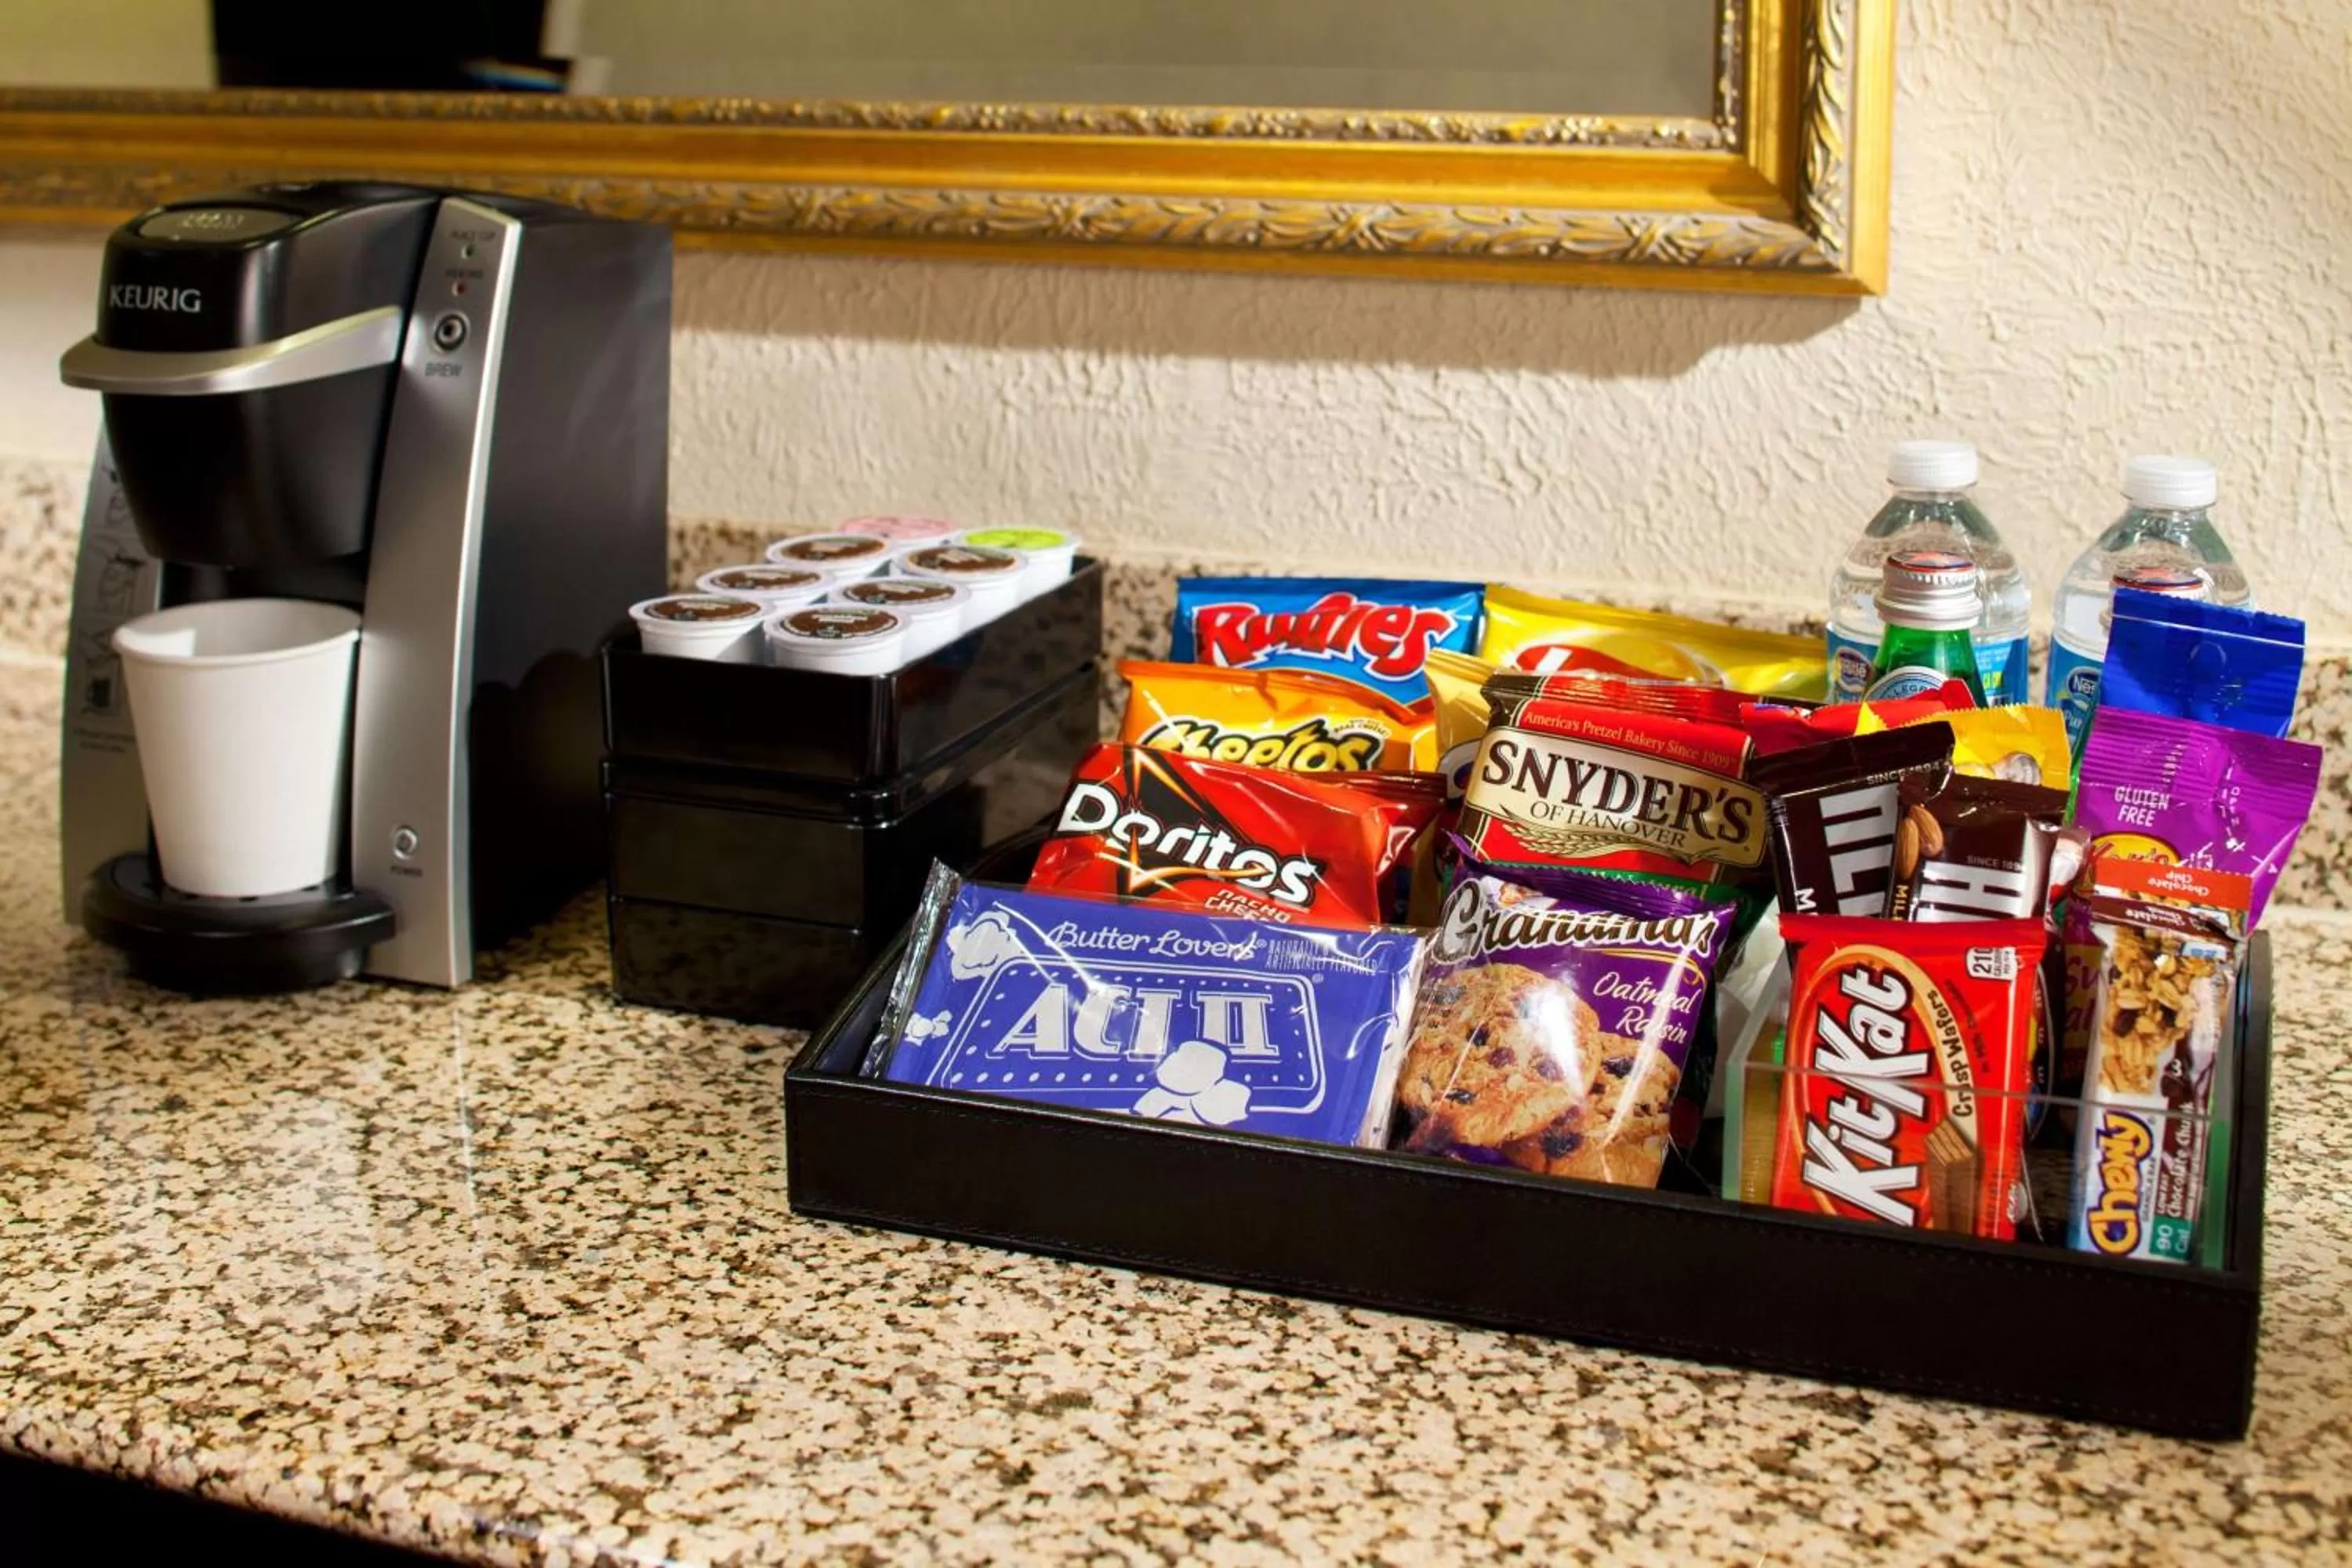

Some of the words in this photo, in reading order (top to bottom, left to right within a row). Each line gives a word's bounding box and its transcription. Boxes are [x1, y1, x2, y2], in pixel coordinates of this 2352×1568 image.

[110, 284, 201, 313] KEURIG
[1194, 592, 1453, 677] Ruffles
[1524, 711, 1580, 731] America's
[1582, 719, 1622, 740] Pretzel
[1624, 728, 1664, 753] Bakery
[1667, 739, 1699, 760] Since
[1482, 739, 1753, 844] SNYDER'S
[2114, 786, 2171, 811] GLUTEN
[2118, 804, 2156, 827] FREE
[1058, 783, 1320, 905] Doritos
[1530, 800, 1563, 821] OF
[1568, 809, 1685, 848] HANOVER
[1892, 884, 1909, 921] MIL
[2147, 877, 2211, 897] Chocolate
[1047, 920, 1151, 952] Butter
[1593, 971, 1702, 1014] Oatmeal
[987, 982, 1181, 1061] ACT
[1927, 989, 1964, 1060] Wafers
[1951, 1061, 1973, 1117] Crisp
[2087, 1110, 2154, 1255] Chewy
[2167, 1148, 2188, 1218] Chocolate
